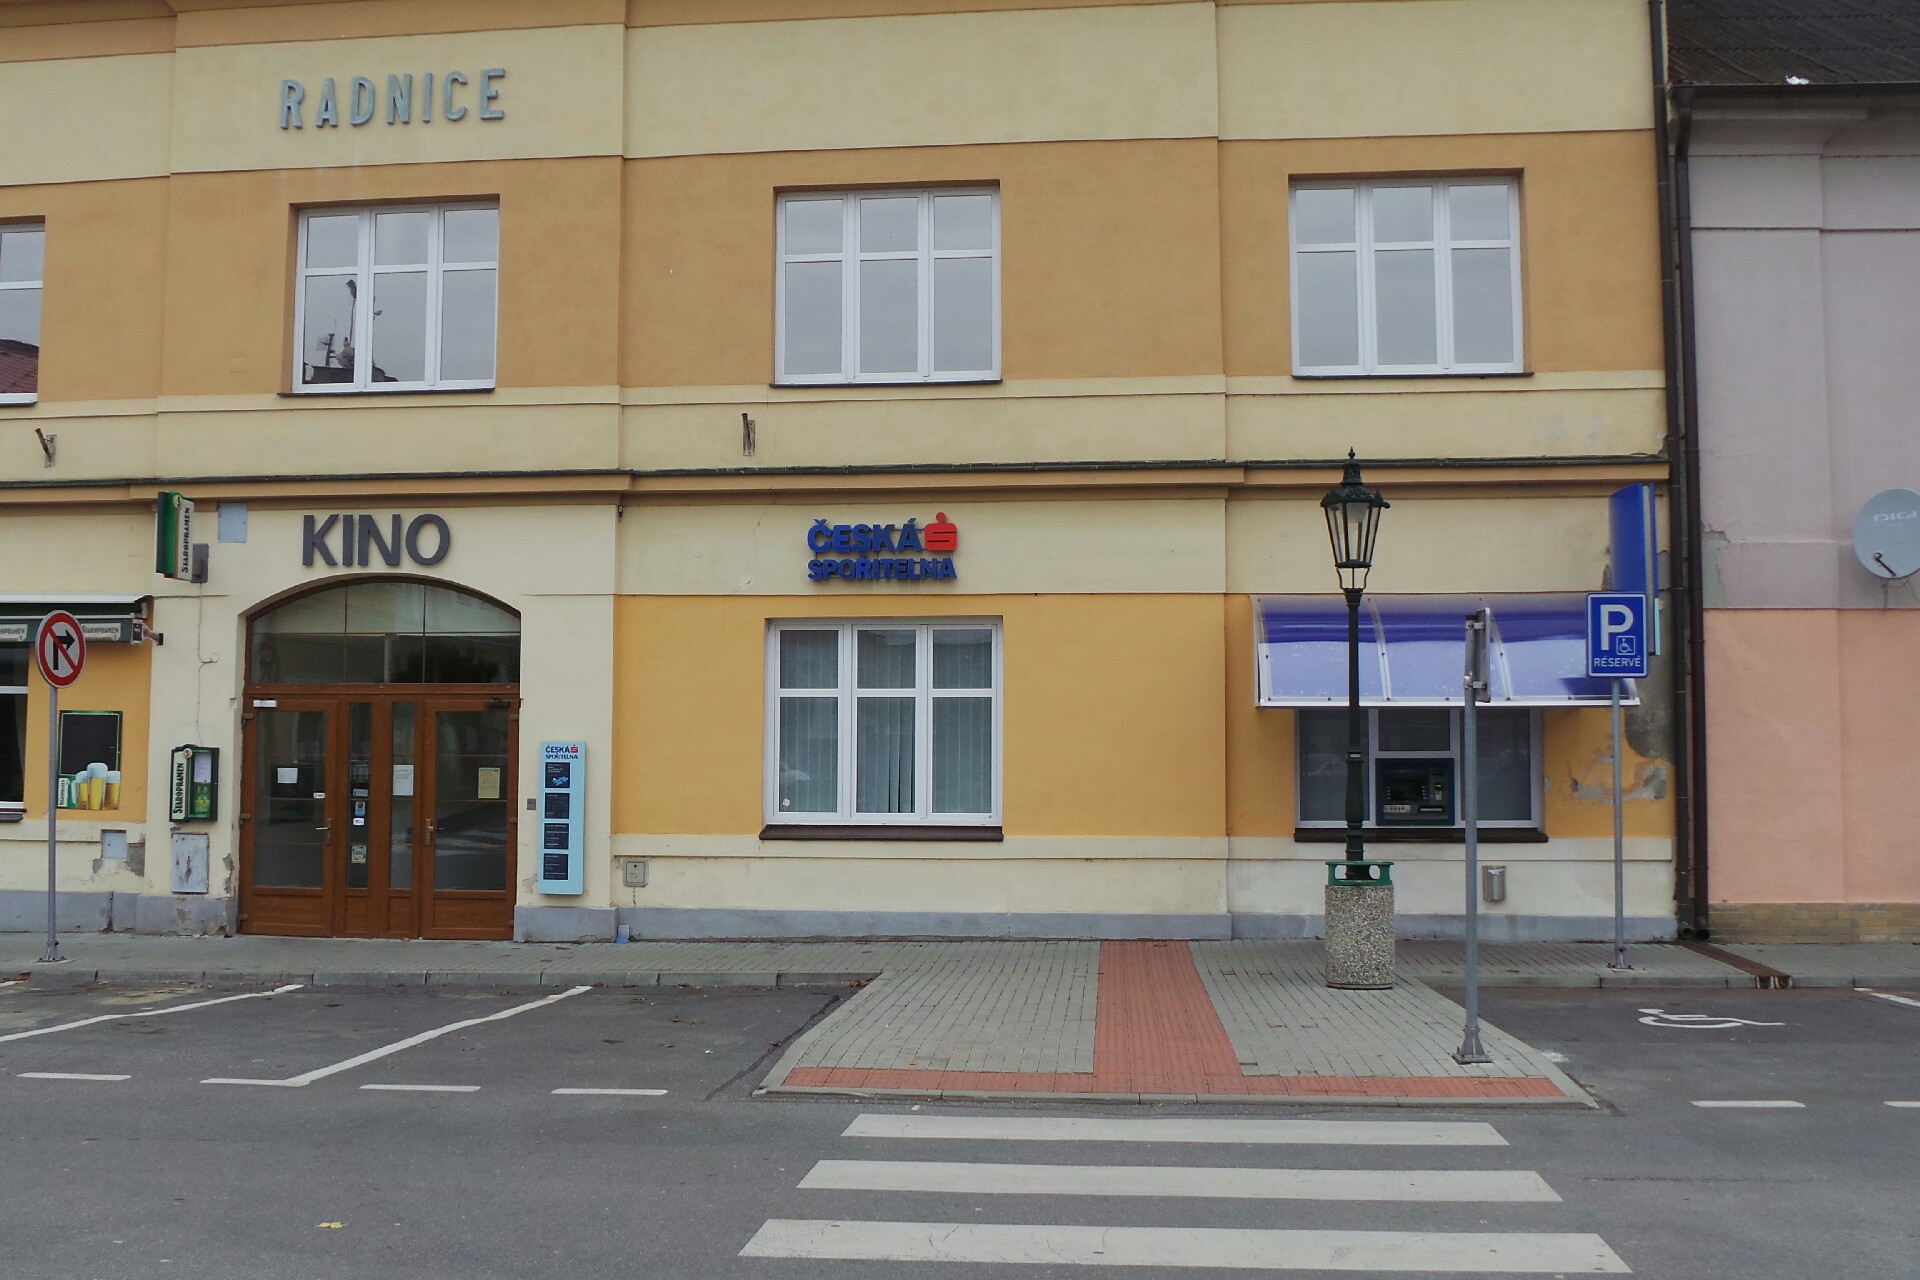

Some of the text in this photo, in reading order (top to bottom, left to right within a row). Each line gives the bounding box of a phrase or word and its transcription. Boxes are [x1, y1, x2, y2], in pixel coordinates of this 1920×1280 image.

[280, 67, 507, 130] RADNICE
[181, 507, 190, 574] STAROPRAMEN
[302, 513, 451, 566] KINO
[807, 518, 923, 552] ČESKÁ
[807, 553, 957, 581] SPOŘITELNA
[1600, 604, 1634, 651] P
[1593, 655, 1642, 667] RÉSERVÉ
[545, 744, 570, 754] ČESKÁ
[173, 762, 184, 814] STAROPRAMEN
